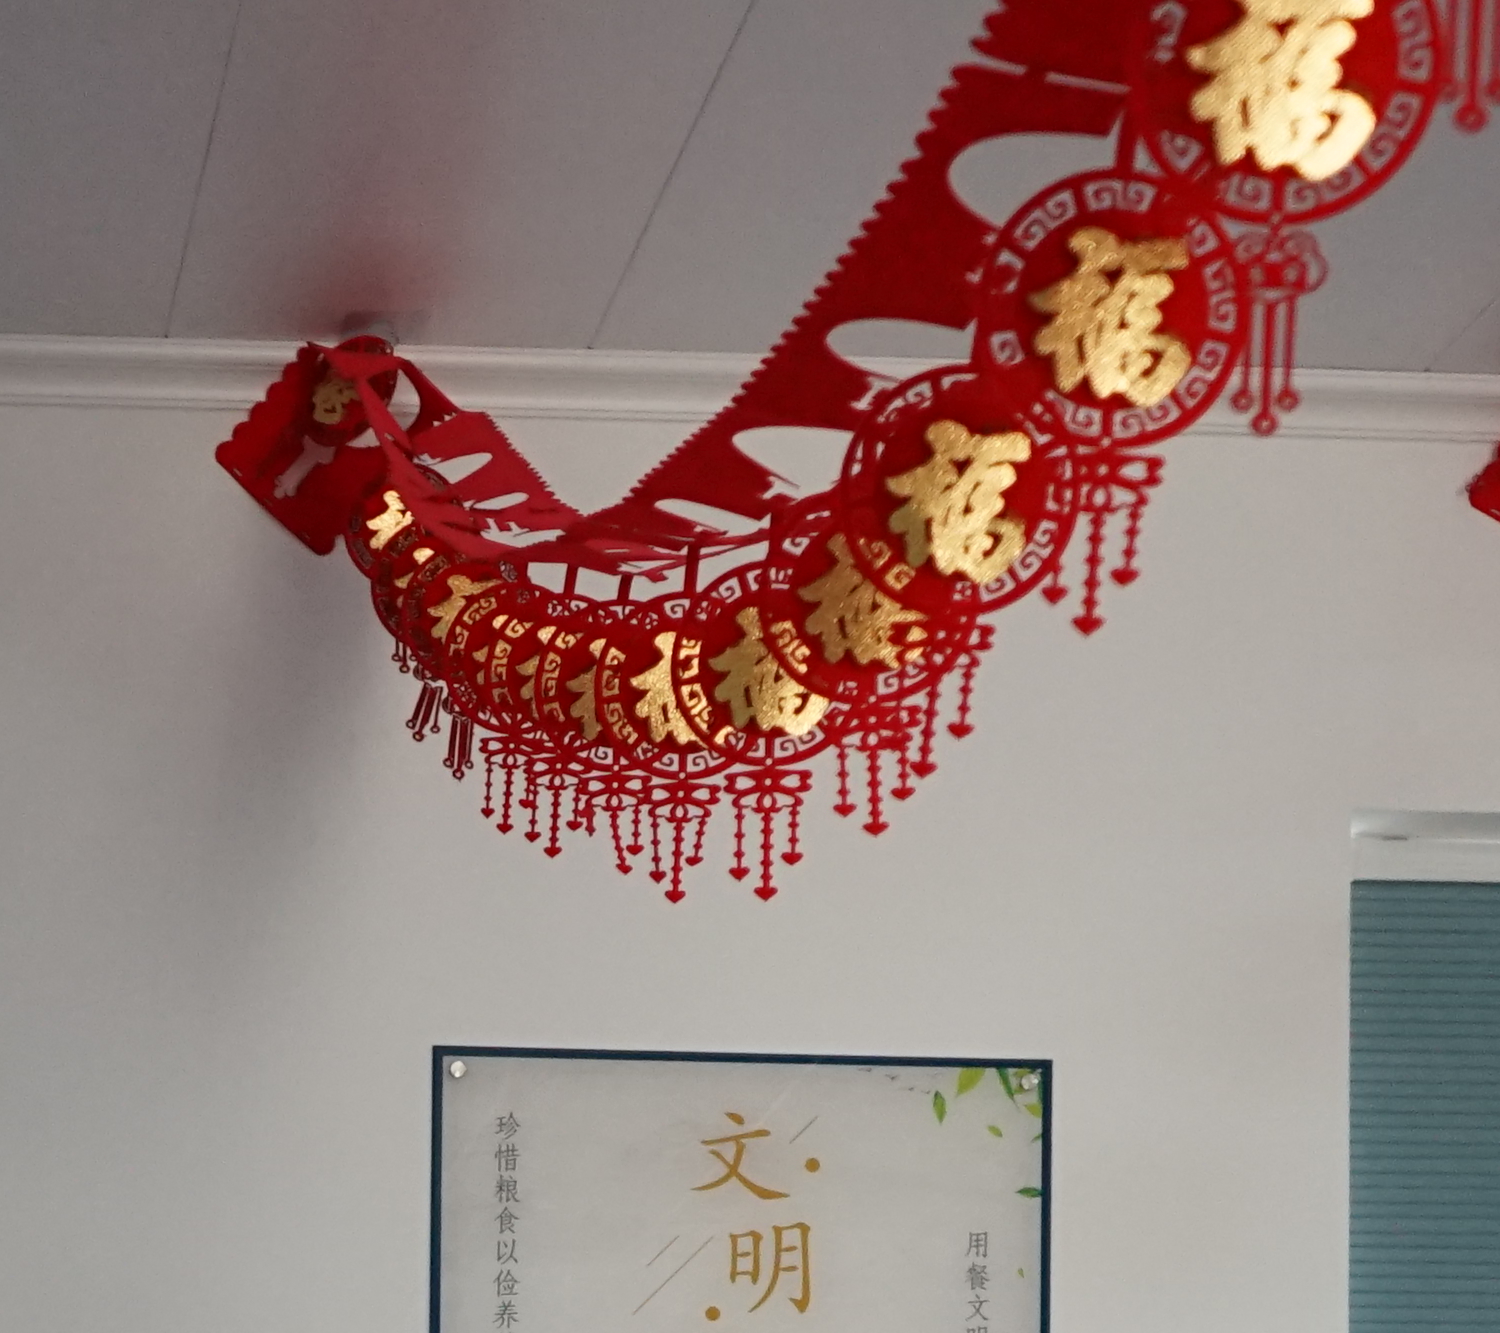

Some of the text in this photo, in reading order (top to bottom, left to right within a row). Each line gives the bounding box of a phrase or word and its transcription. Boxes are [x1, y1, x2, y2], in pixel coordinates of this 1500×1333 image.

[1187, 0, 1376, 181] 福
[1029, 226, 1191, 407] 福
[887, 420, 1031, 584] 福
